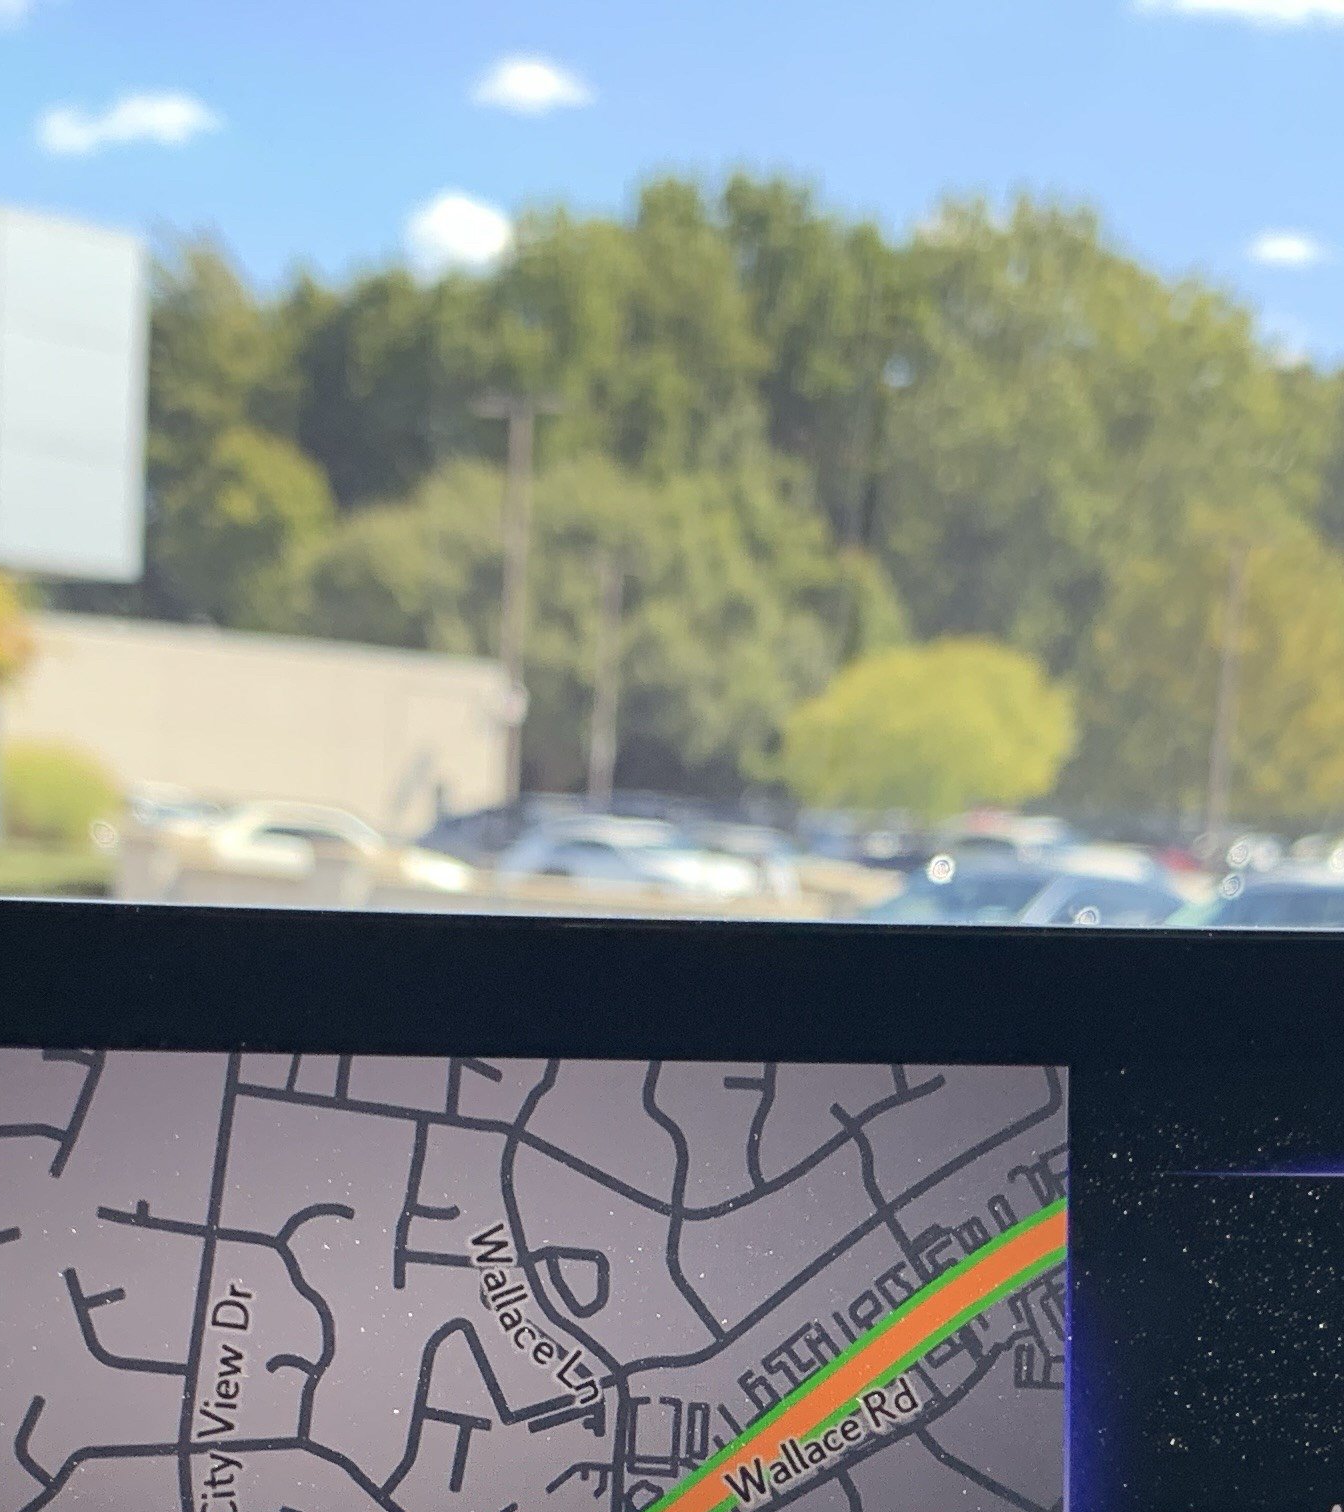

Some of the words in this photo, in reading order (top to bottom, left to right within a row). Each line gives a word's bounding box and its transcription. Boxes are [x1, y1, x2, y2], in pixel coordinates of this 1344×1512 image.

[211, 1284, 253, 1331] Dr
[471, 1223, 555, 1365] Wallace
[556, 1350, 599, 1404] Ln
[197, 1344, 244, 1438] View
[724, 1418, 862, 1503] Wallace
[862, 1377, 919, 1428] Rd
